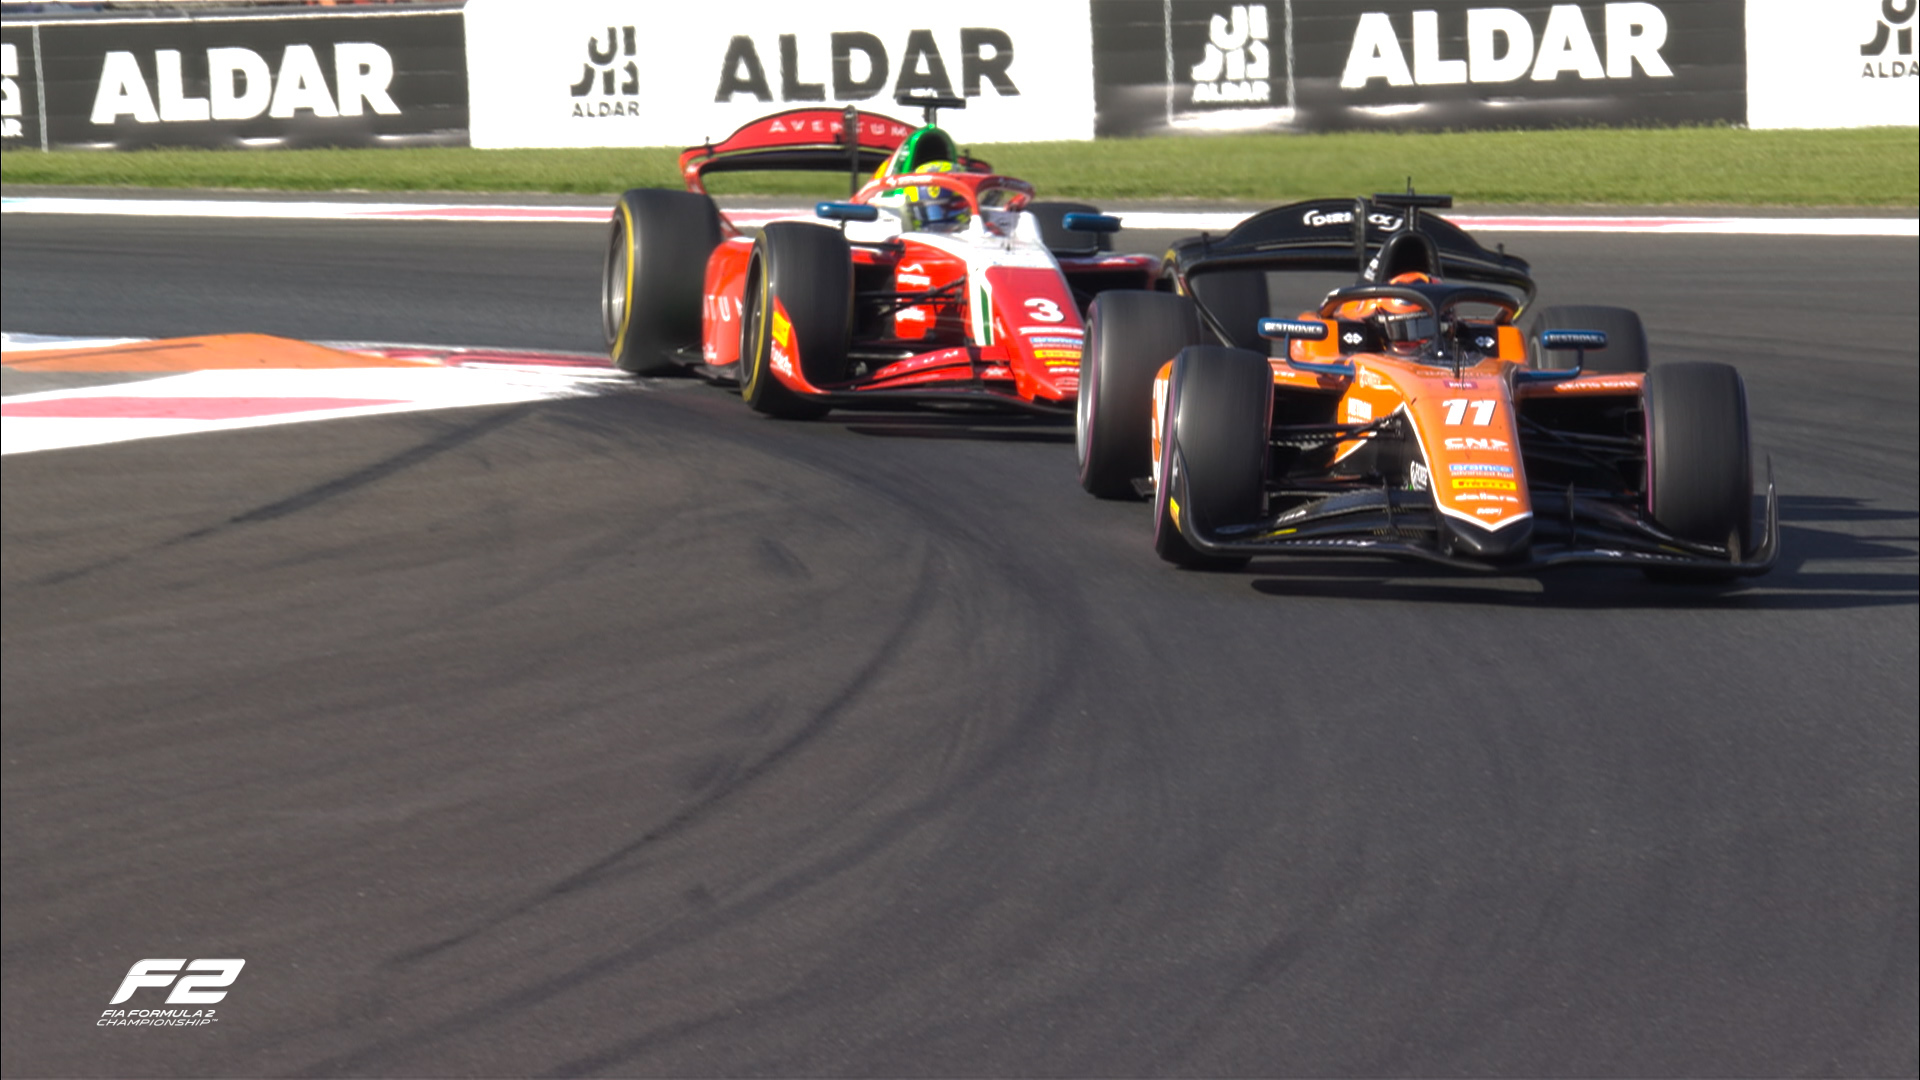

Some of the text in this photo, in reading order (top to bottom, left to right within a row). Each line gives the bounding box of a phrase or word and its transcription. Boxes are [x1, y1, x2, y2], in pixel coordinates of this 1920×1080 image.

[1341, 2, 1675, 88] ALDAR
[714, 27, 1021, 103] ALDAR
[90, 42, 402, 124] ALDAR
[1192, 81, 1271, 102] ALDAR
[571, 101, 640, 118] ALDAR
[1024, 297, 1064, 322] 3
[1442, 398, 1497, 426] 11
